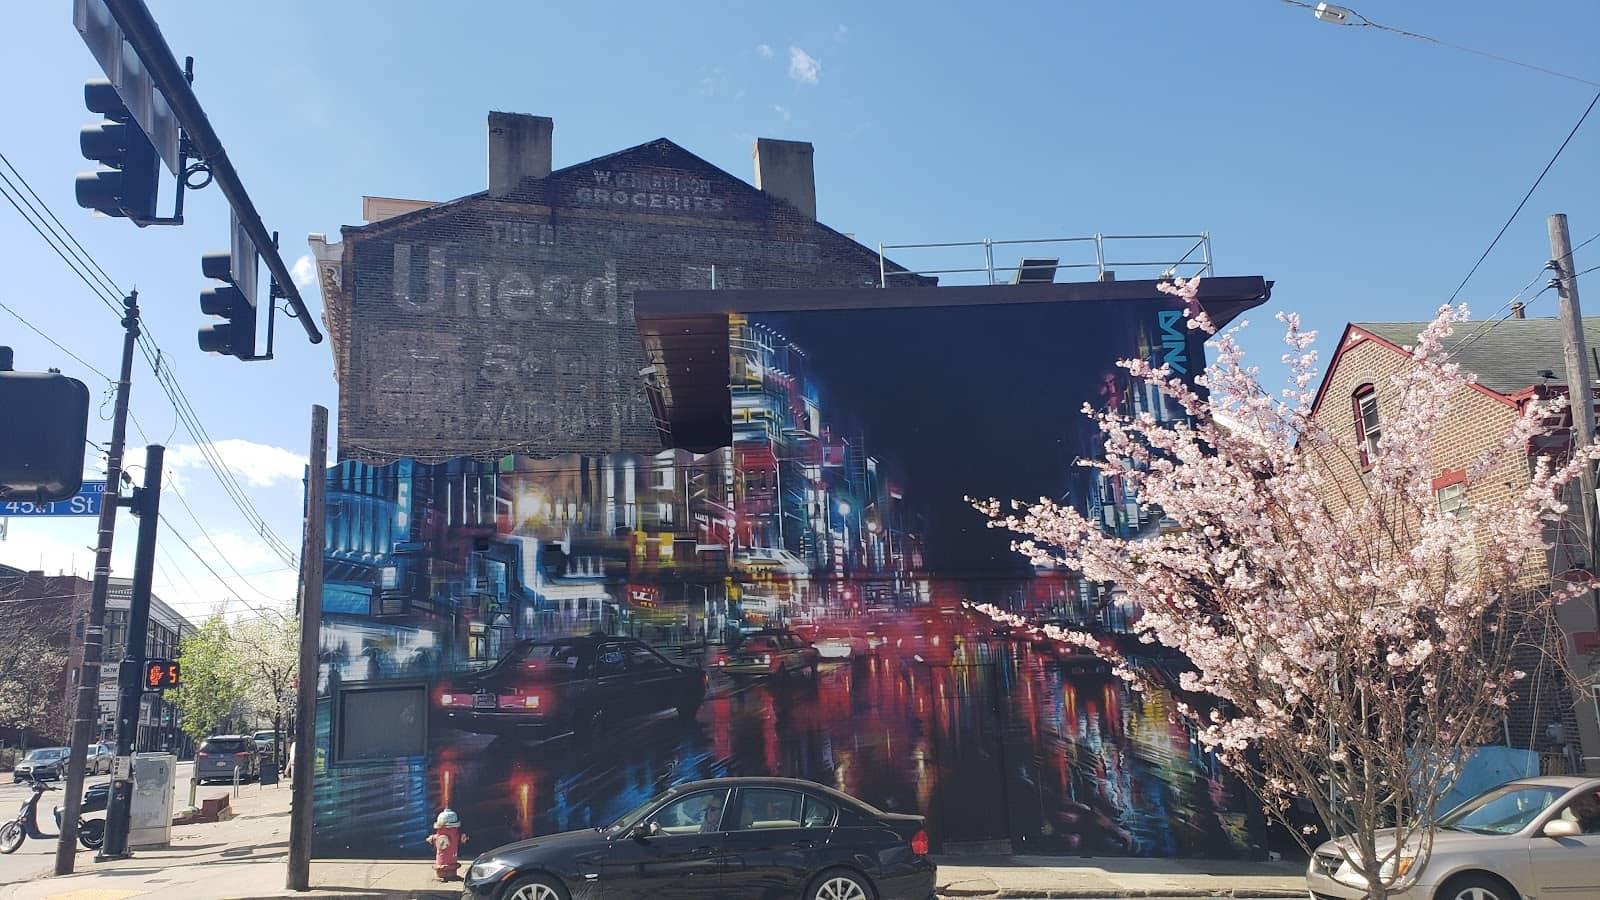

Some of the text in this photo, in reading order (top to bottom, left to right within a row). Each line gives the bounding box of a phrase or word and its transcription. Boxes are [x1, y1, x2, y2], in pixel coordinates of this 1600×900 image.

[576, 188, 726, 212] GROCERIES
[70, 495, 94, 514] St
[169, 665, 177, 684] 5
